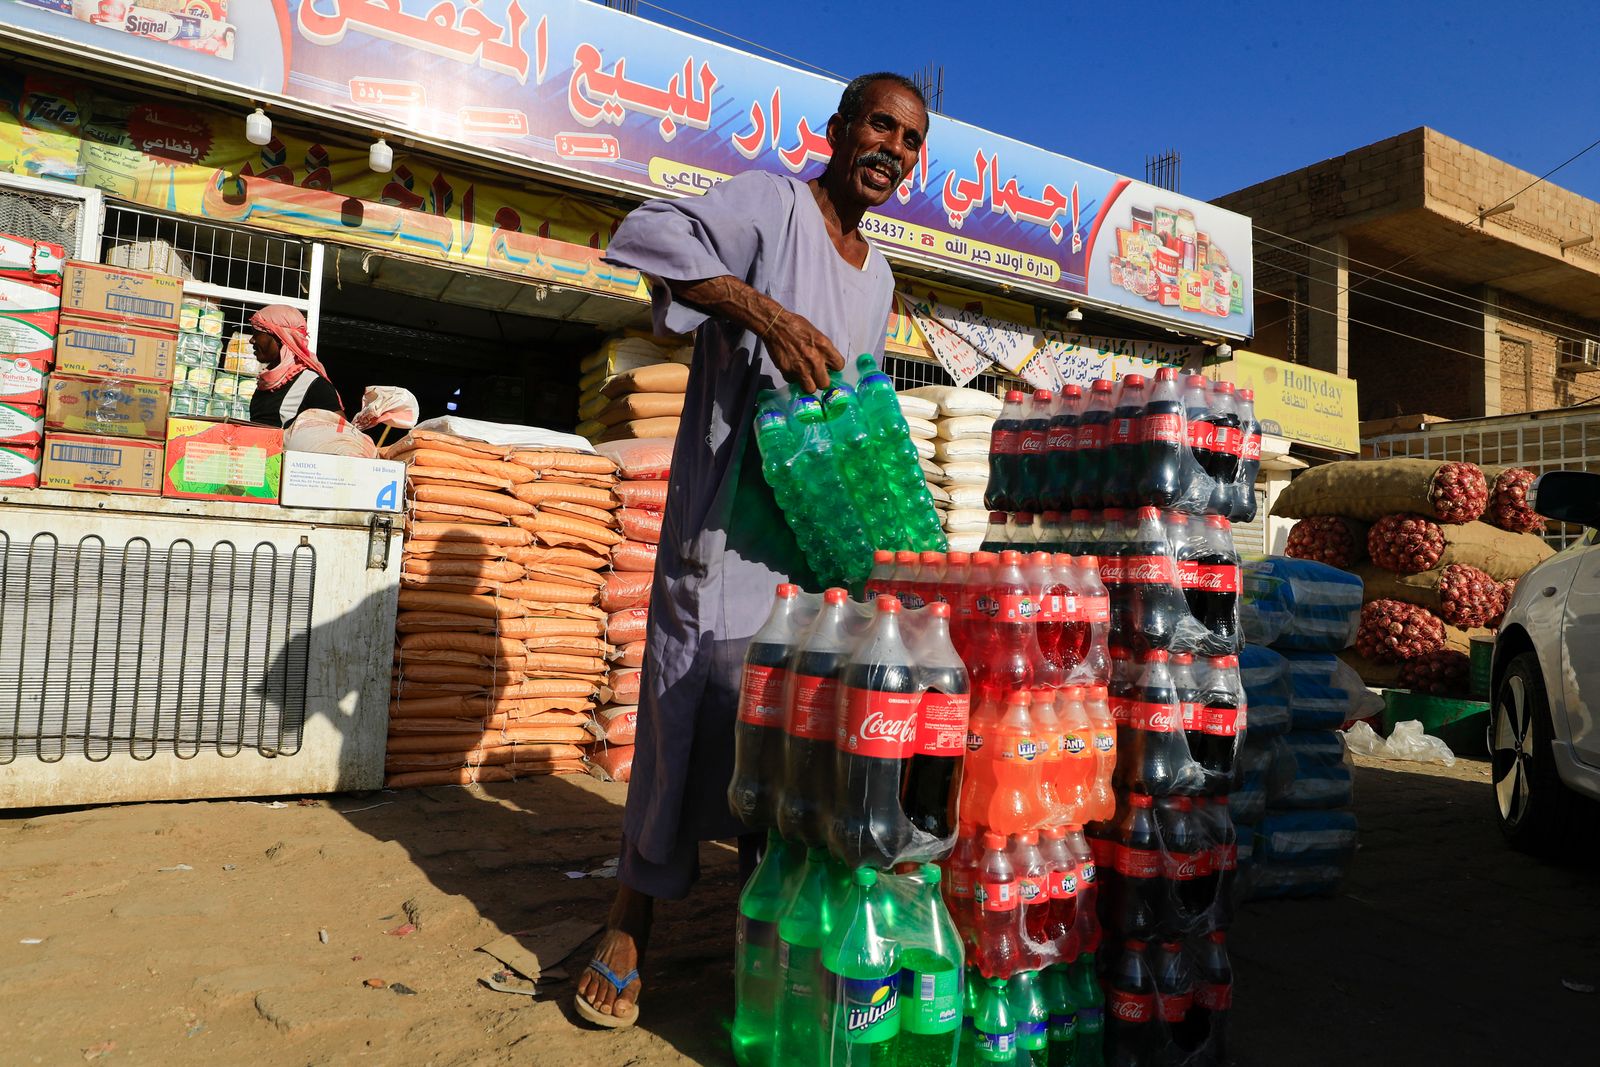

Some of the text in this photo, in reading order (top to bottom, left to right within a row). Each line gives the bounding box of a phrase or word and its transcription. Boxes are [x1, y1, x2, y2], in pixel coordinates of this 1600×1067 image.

[125, 15, 167, 35] Signal
[568, 43, 718, 142] للبيع
[26, 94, 79, 124] Tide
[142, 137, 199, 158] وقطاعي
[945, 239, 967, 255] الله
[971, 247, 991, 264] جبر
[995, 252, 1023, 272] أولاد
[155, 279, 176, 287] TUNA
[1187, 282, 1201, 294] Lipt
[63, 362, 86, 371] TUNA
[137, 387, 159, 395] TUNA
[1284, 369, 1343, 399] Hollyday
[48, 477, 71, 486] TUNA
[1063, 739, 1086, 750] FANTA
[848, 991, 897, 1030] سبرايت
